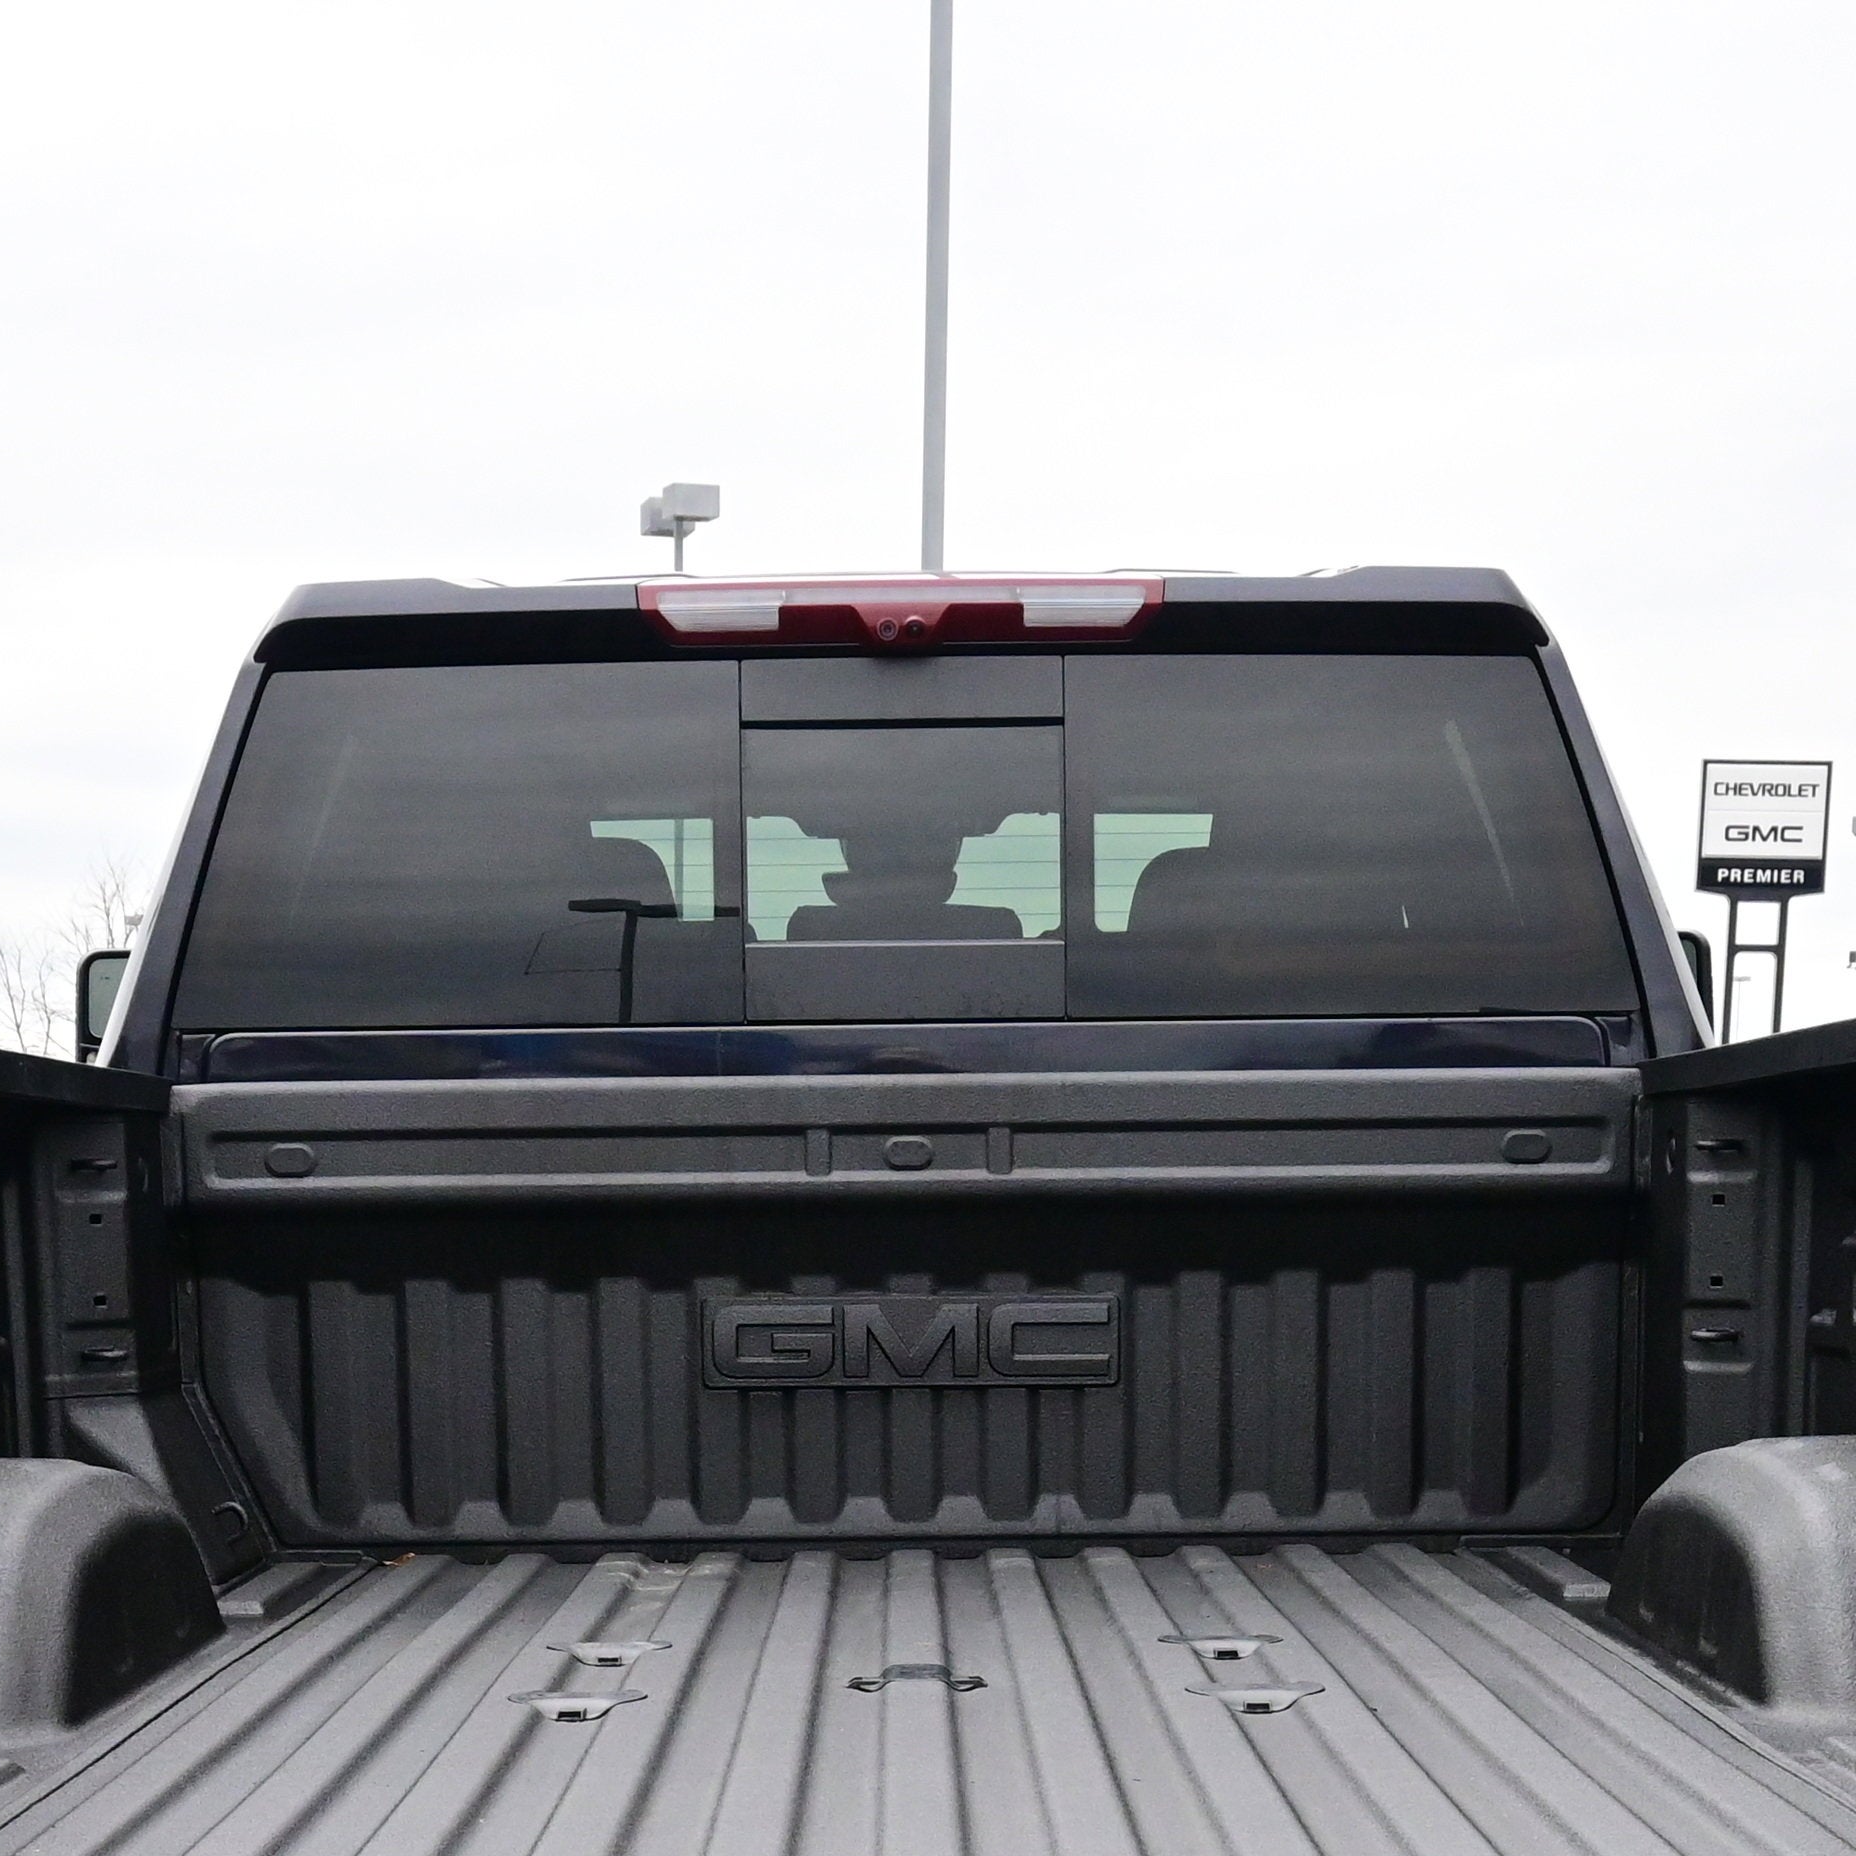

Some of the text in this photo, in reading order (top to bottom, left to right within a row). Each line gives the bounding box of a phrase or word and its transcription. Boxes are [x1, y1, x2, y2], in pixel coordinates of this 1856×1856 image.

[1713, 782, 1820, 798] CHEVROLET
[1724, 825, 1803, 843] GMC
[1717, 868, 1805, 884] PREMIER
[712, 1303, 1111, 1378] GMC
